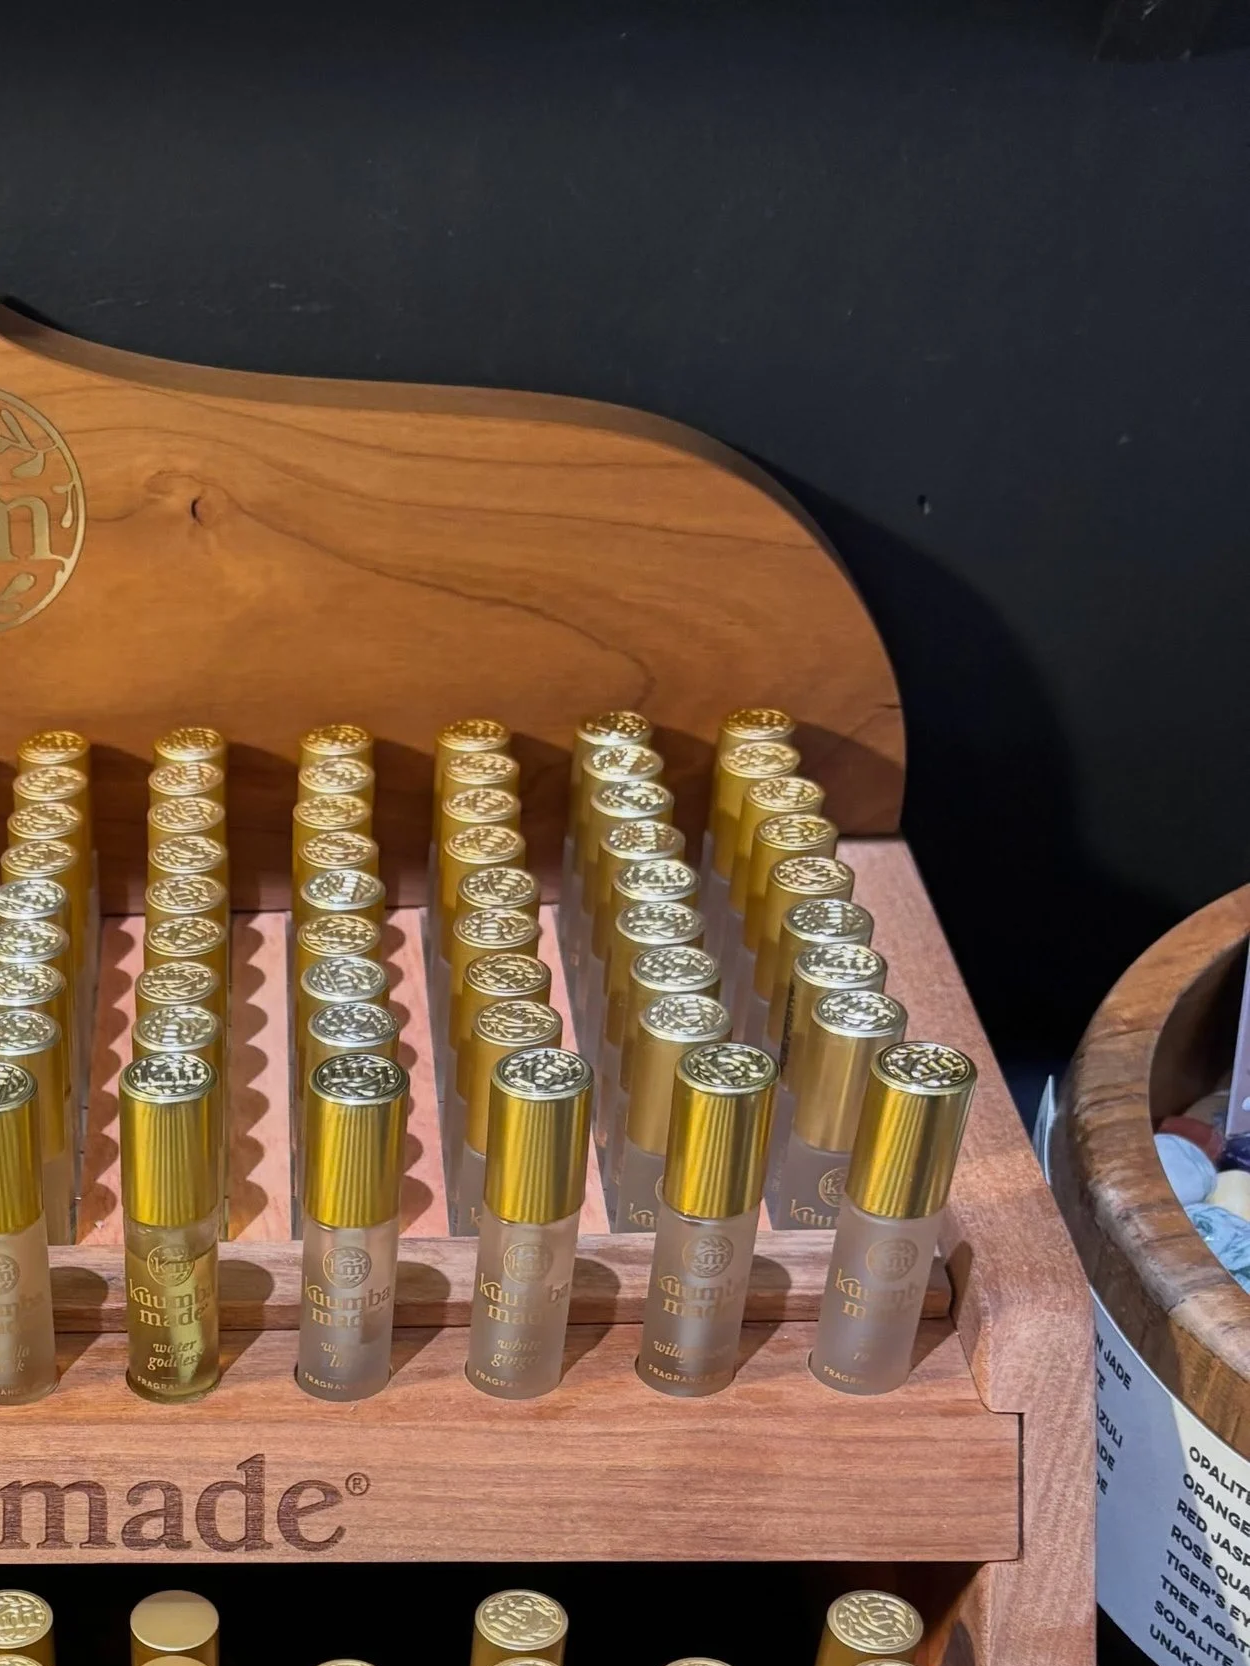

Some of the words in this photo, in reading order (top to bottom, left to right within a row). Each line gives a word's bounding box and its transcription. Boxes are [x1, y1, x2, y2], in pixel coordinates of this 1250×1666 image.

[152, 1339, 197, 1353] water
[1103, 1349, 1132, 1391] JADE
[1177, 1498, 1208, 1533] RED
[1170, 1524, 1213, 1569] ROSE
[1160, 1574, 1200, 1618] TREE
